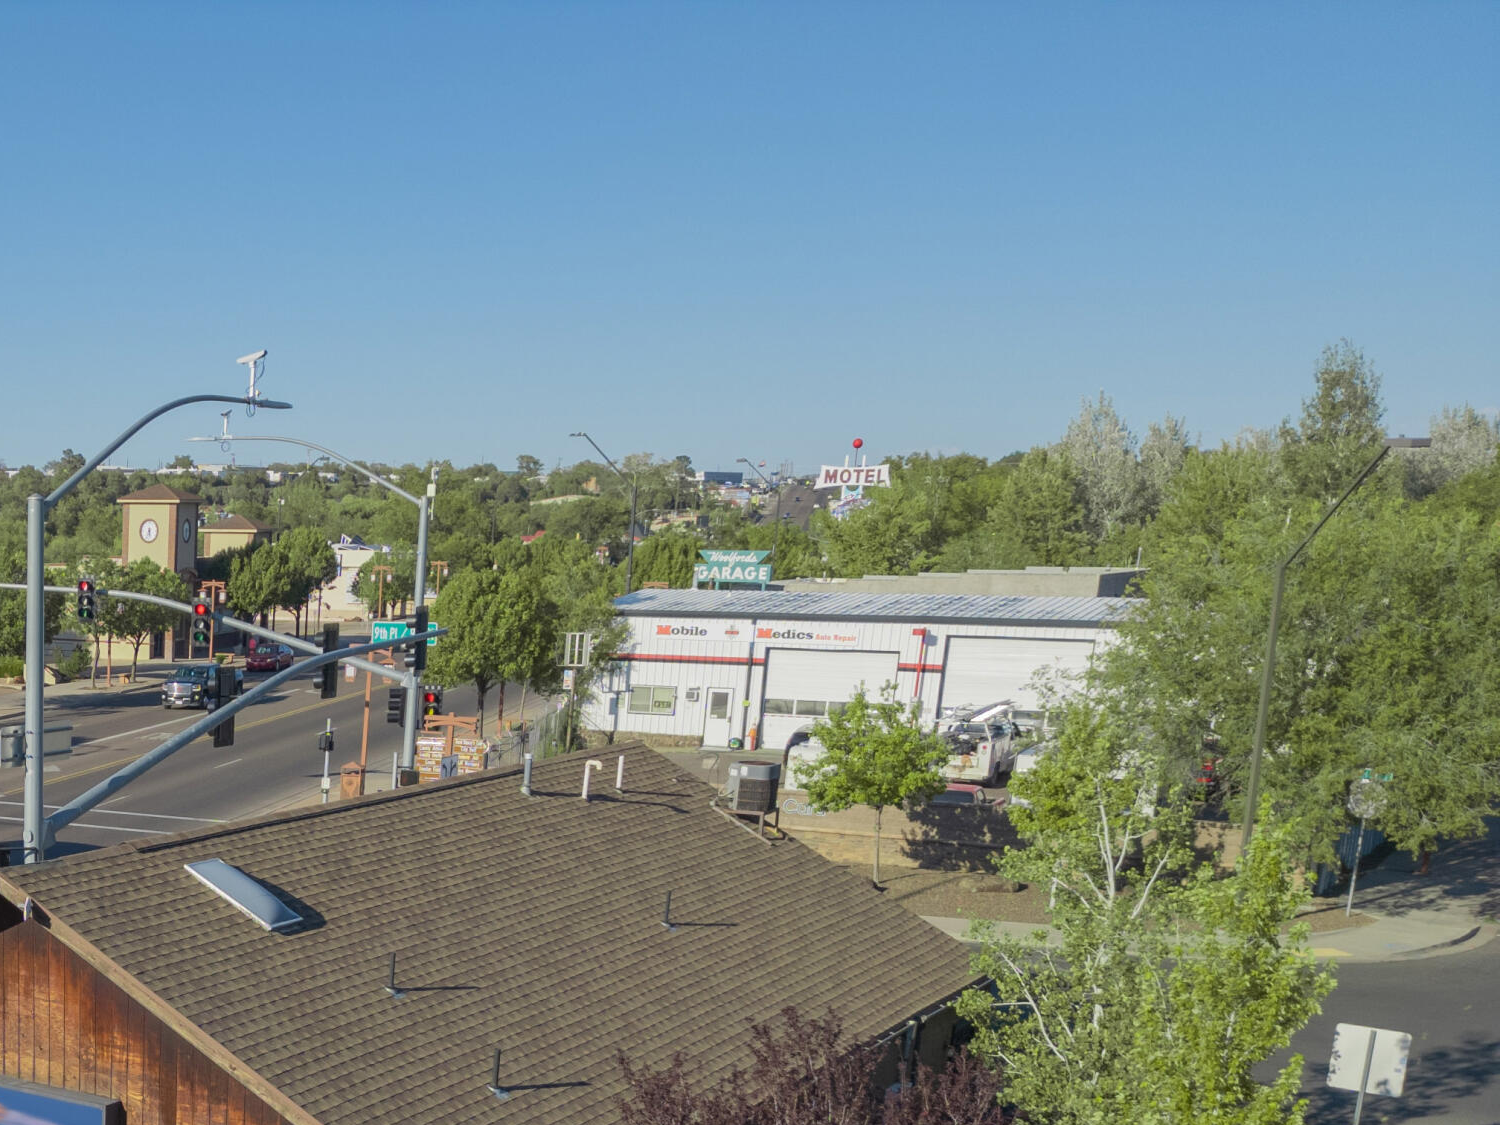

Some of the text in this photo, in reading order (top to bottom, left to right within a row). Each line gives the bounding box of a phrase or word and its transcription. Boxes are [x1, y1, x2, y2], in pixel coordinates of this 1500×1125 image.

[823, 469, 886, 484] MOTEL
[698, 565, 768, 580] GARAGE
[374, 626, 388, 640] 9th
[656, 625, 857, 643] Mobile Medics Auto Repair
